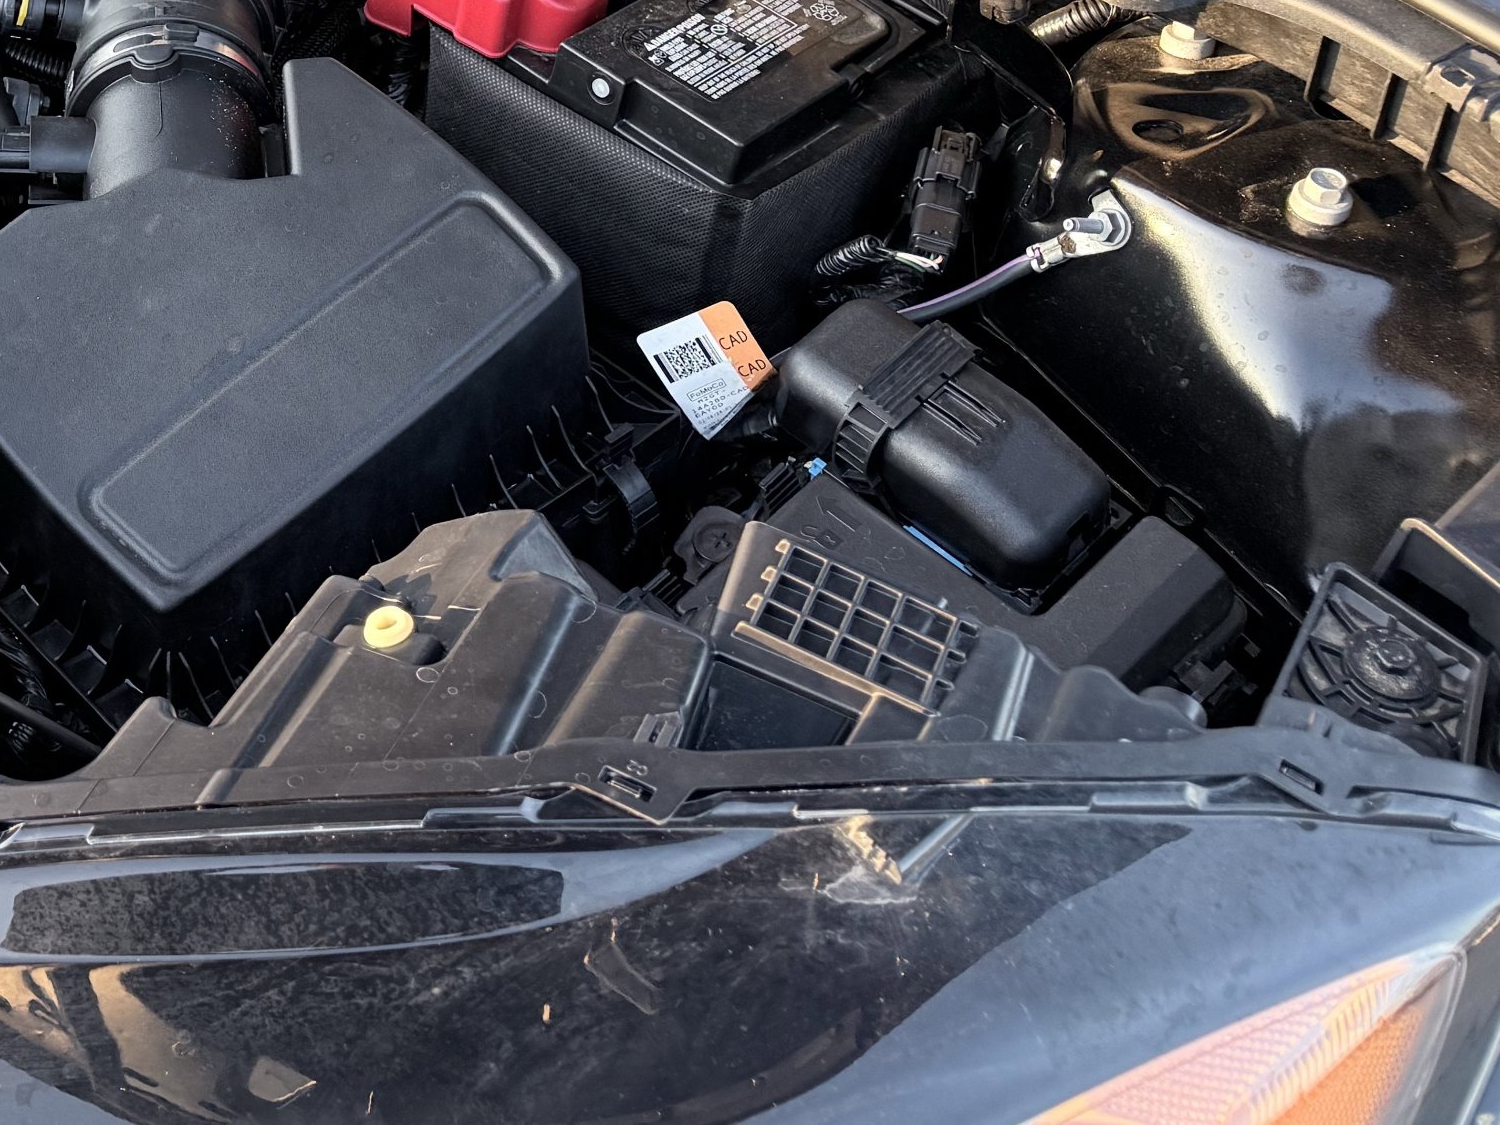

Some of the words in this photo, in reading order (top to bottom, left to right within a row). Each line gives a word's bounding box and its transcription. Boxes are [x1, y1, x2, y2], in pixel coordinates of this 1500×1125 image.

[718, 330, 748, 350] CAD
[737, 359, 767, 377] CAD
[689, 381, 724, 399] FoMoCo
